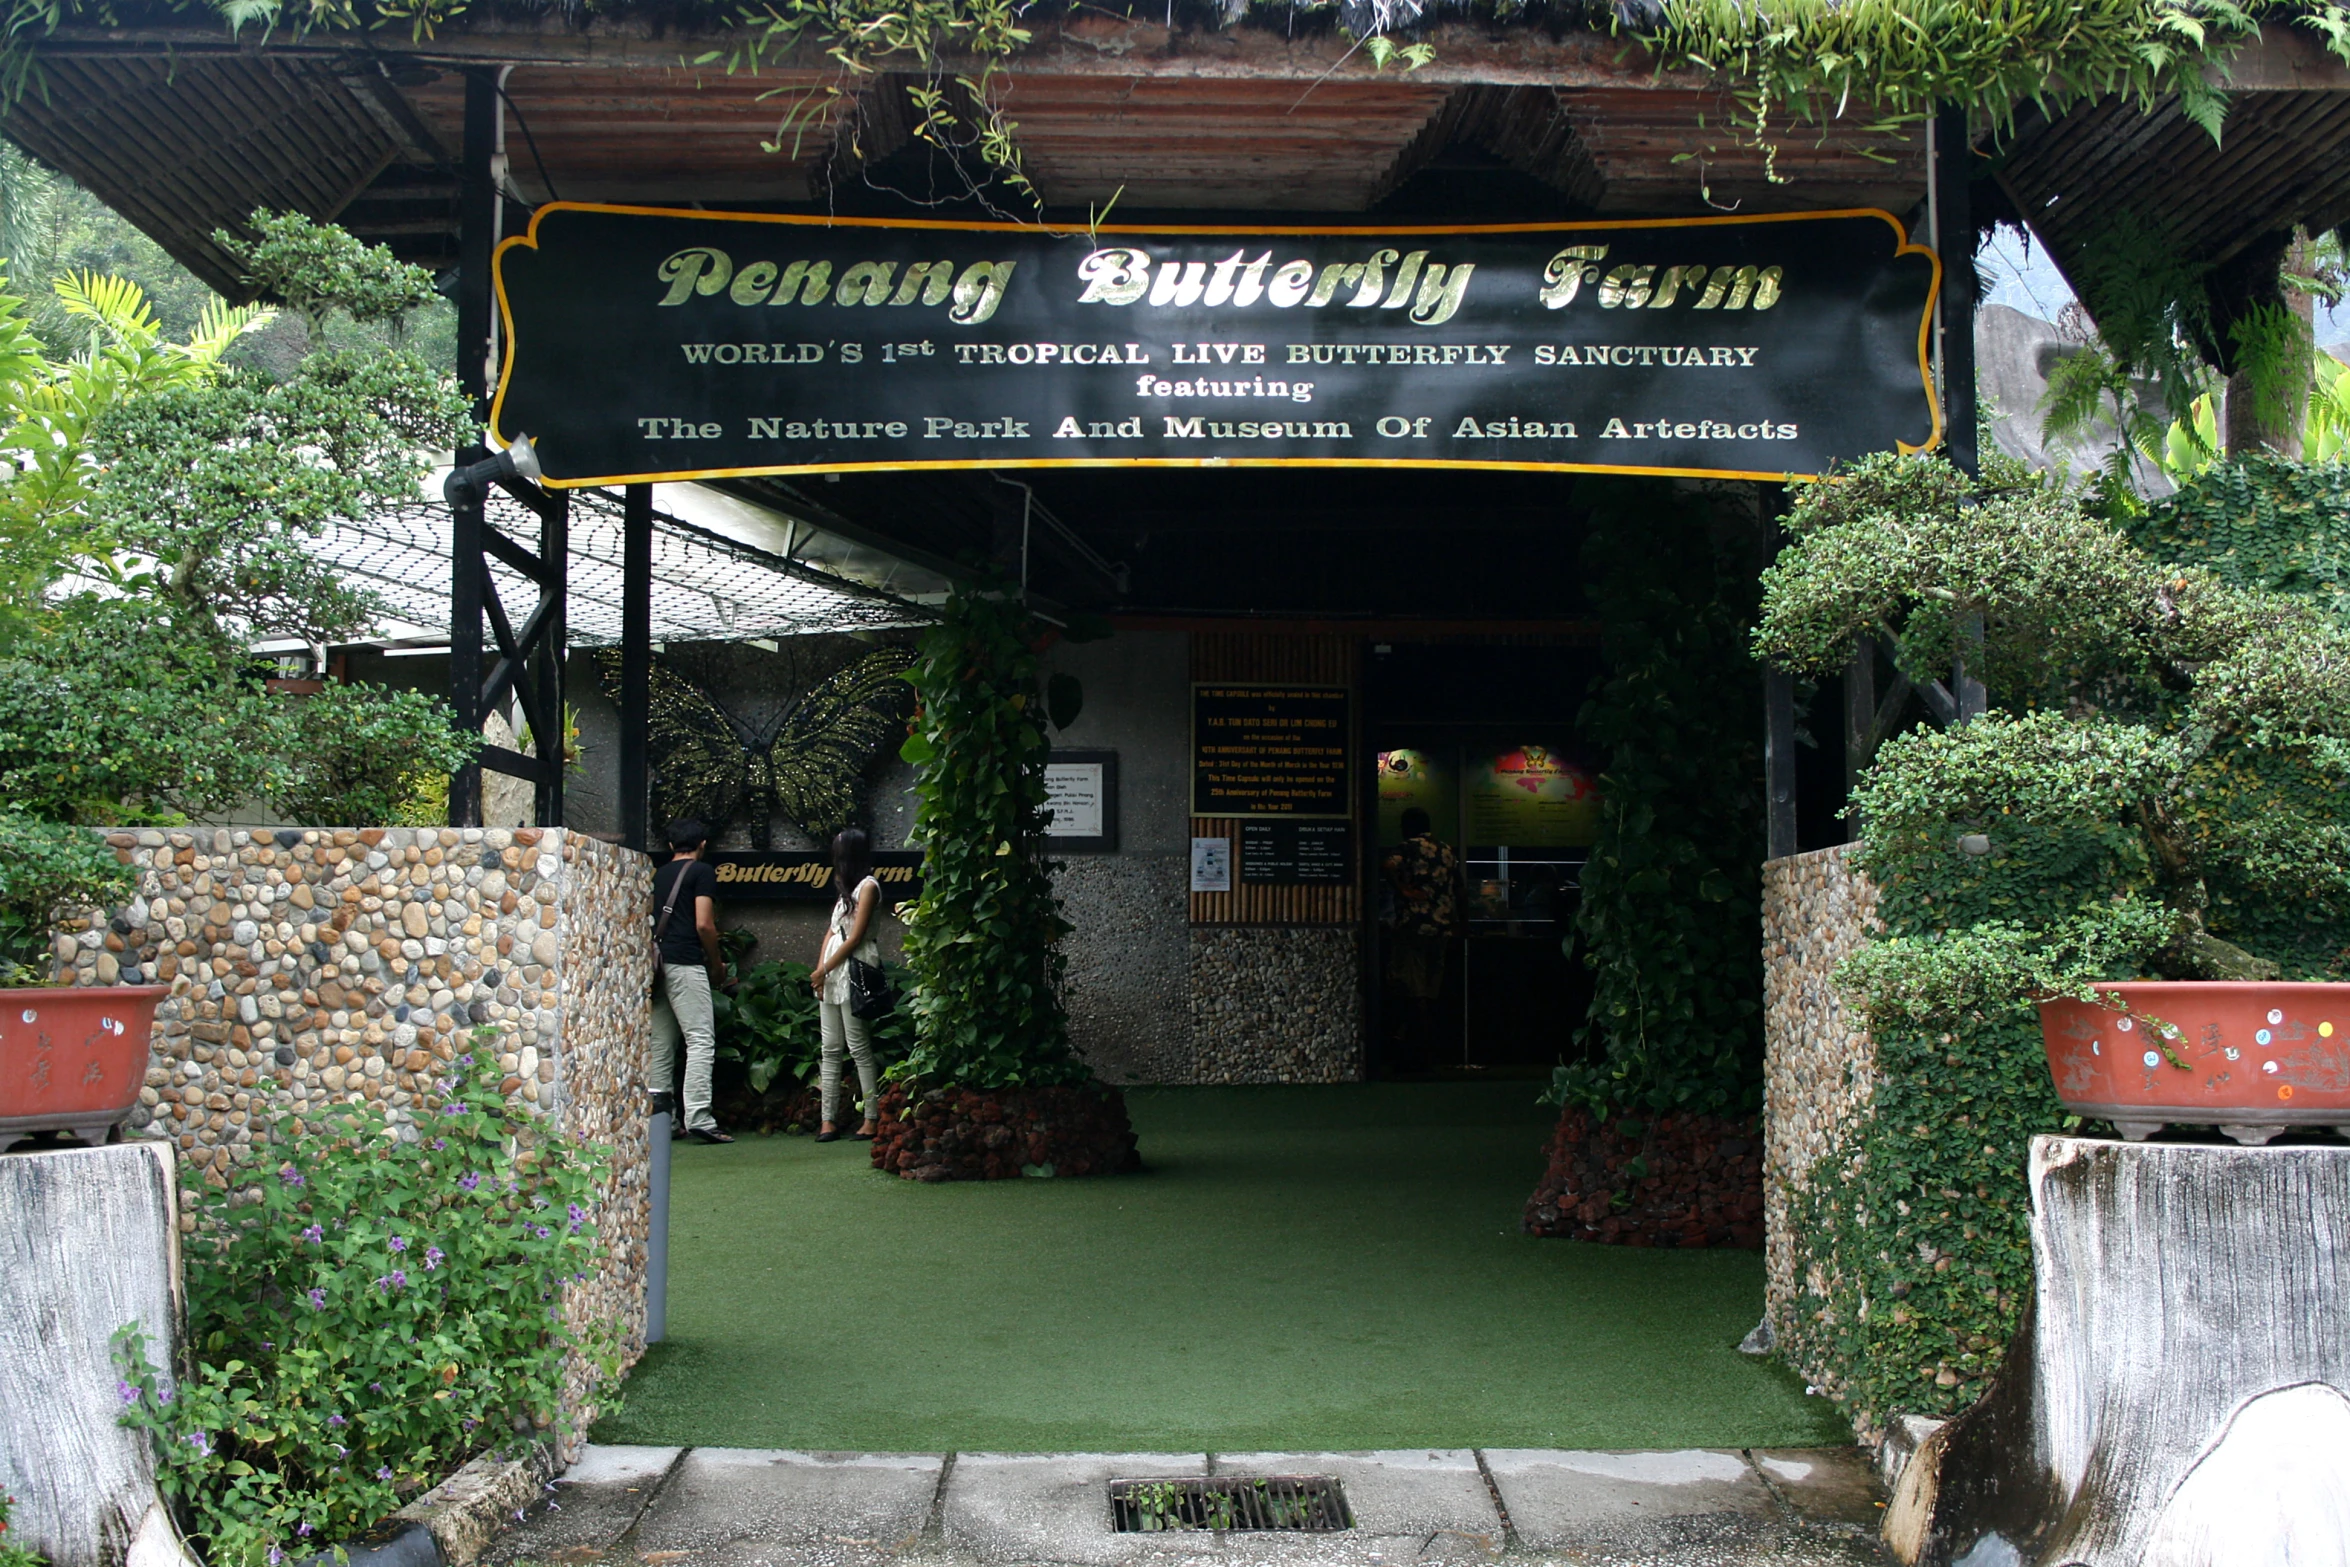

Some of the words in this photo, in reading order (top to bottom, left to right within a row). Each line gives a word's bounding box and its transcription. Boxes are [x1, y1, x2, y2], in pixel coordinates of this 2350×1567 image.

[658, 247, 1017, 325] Penang
[1076, 247, 1476, 325] Butterfly
[1538, 244, 1782, 311] Farm
[681, 340, 863, 364] WORLD'S
[881, 339, 936, 363] 1st
[954, 343, 1149, 365] TROPICAL
[1172, 343, 1266, 365] LIVE
[1286, 345, 1511, 366] BUTTERFLY
[1533, 345, 1760, 367] SANCTUARY
[1135, 374, 1314, 402] featuring
[637, 417, 722, 439] The
[747, 417, 908, 439] Nature
[924, 416, 1031, 439] Park
[1052, 416, 1145, 439] And
[1162, 416, 1353, 439] Museum
[1376, 416, 1433, 439] Of
[1452, 416, 1579, 439] Asian
[1598, 417, 1799, 440] Artefacts
[1268, 704, 1275, 712] by
[1228, 718, 1242, 726] TUN
[1243, 718, 1260, 726] DATO
[1262, 718, 1278, 727] SERI
[1279, 718, 1289, 727] DR
[1291, 719, 1303, 727] LIM
[1304, 719, 1327, 727] CHONG
[1328, 719, 1337, 728] EU
[1217, 746, 1257, 754] ANNIVERSARY
[1293, 747, 1324, 755] BUTTERFLY
[714, 862, 834, 889] Butterfly
